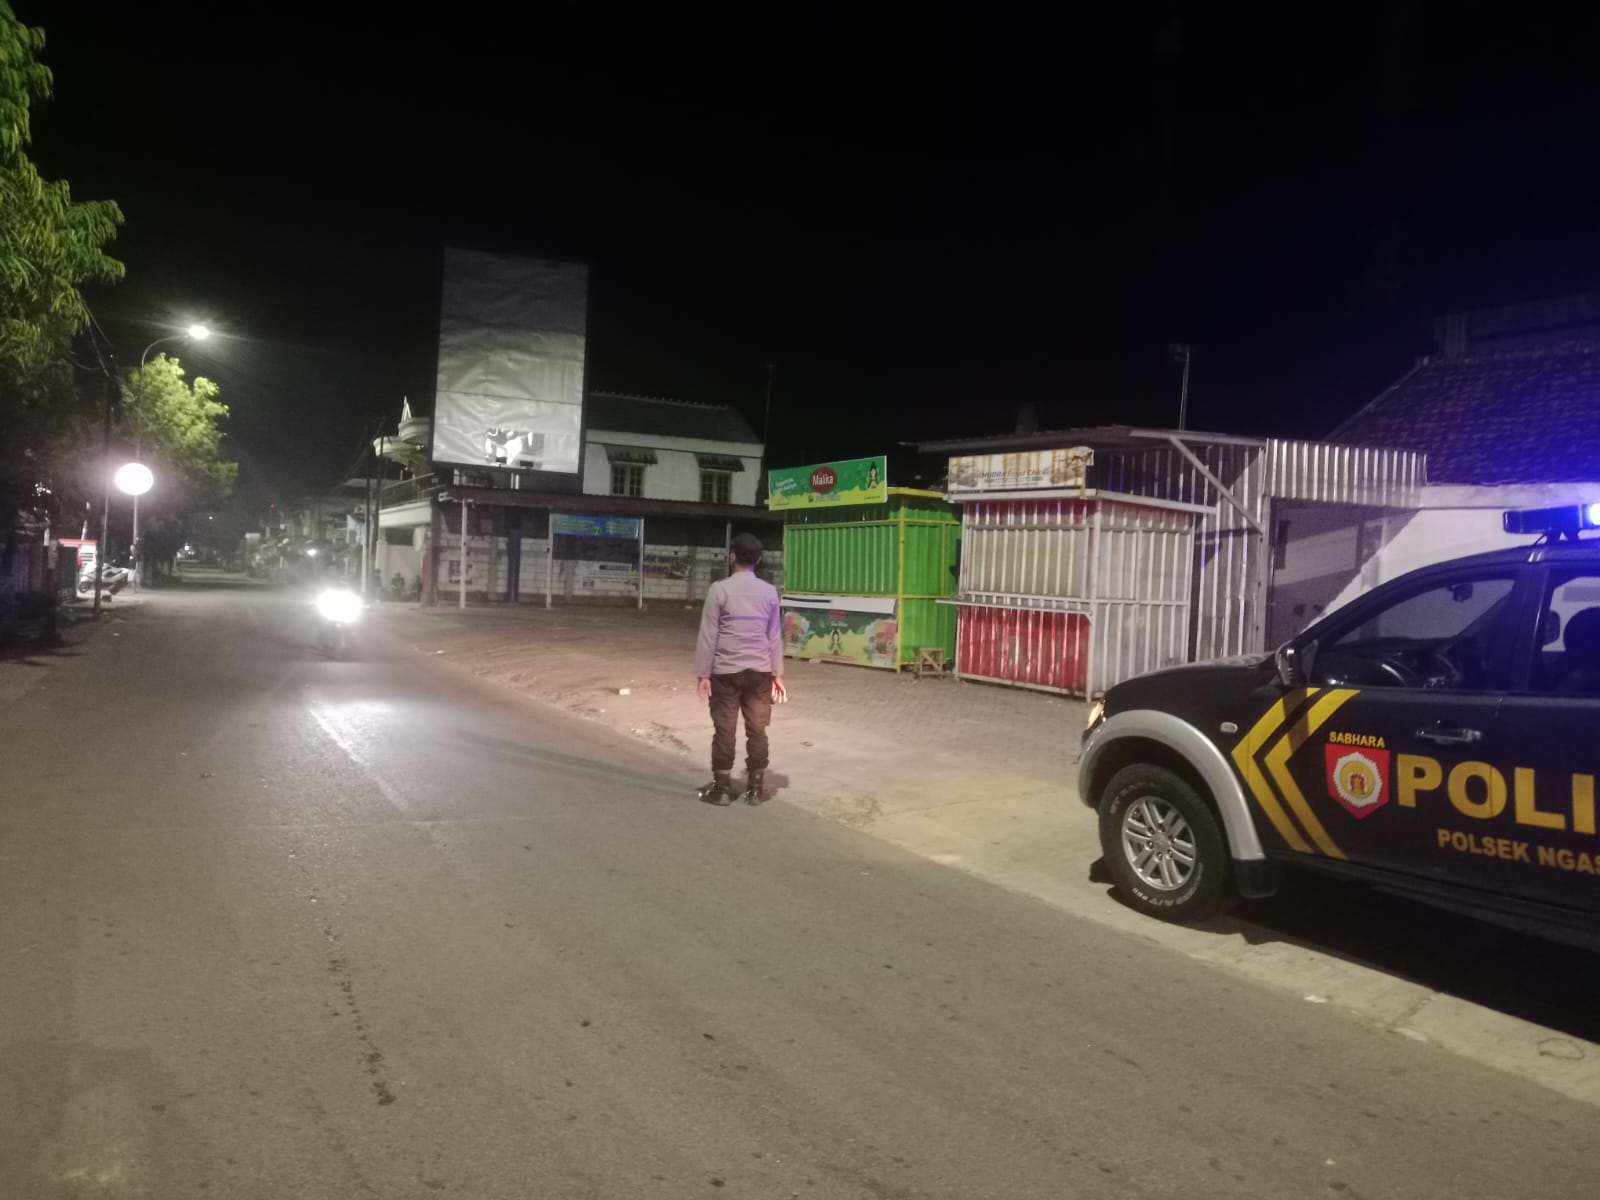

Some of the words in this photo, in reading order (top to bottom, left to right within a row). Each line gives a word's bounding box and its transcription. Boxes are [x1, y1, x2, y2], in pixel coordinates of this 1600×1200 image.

[1329, 731, 1385, 748] SABHARA
[1397, 754, 1596, 834] POLI
[1437, 828, 1531, 863] POLSEK
